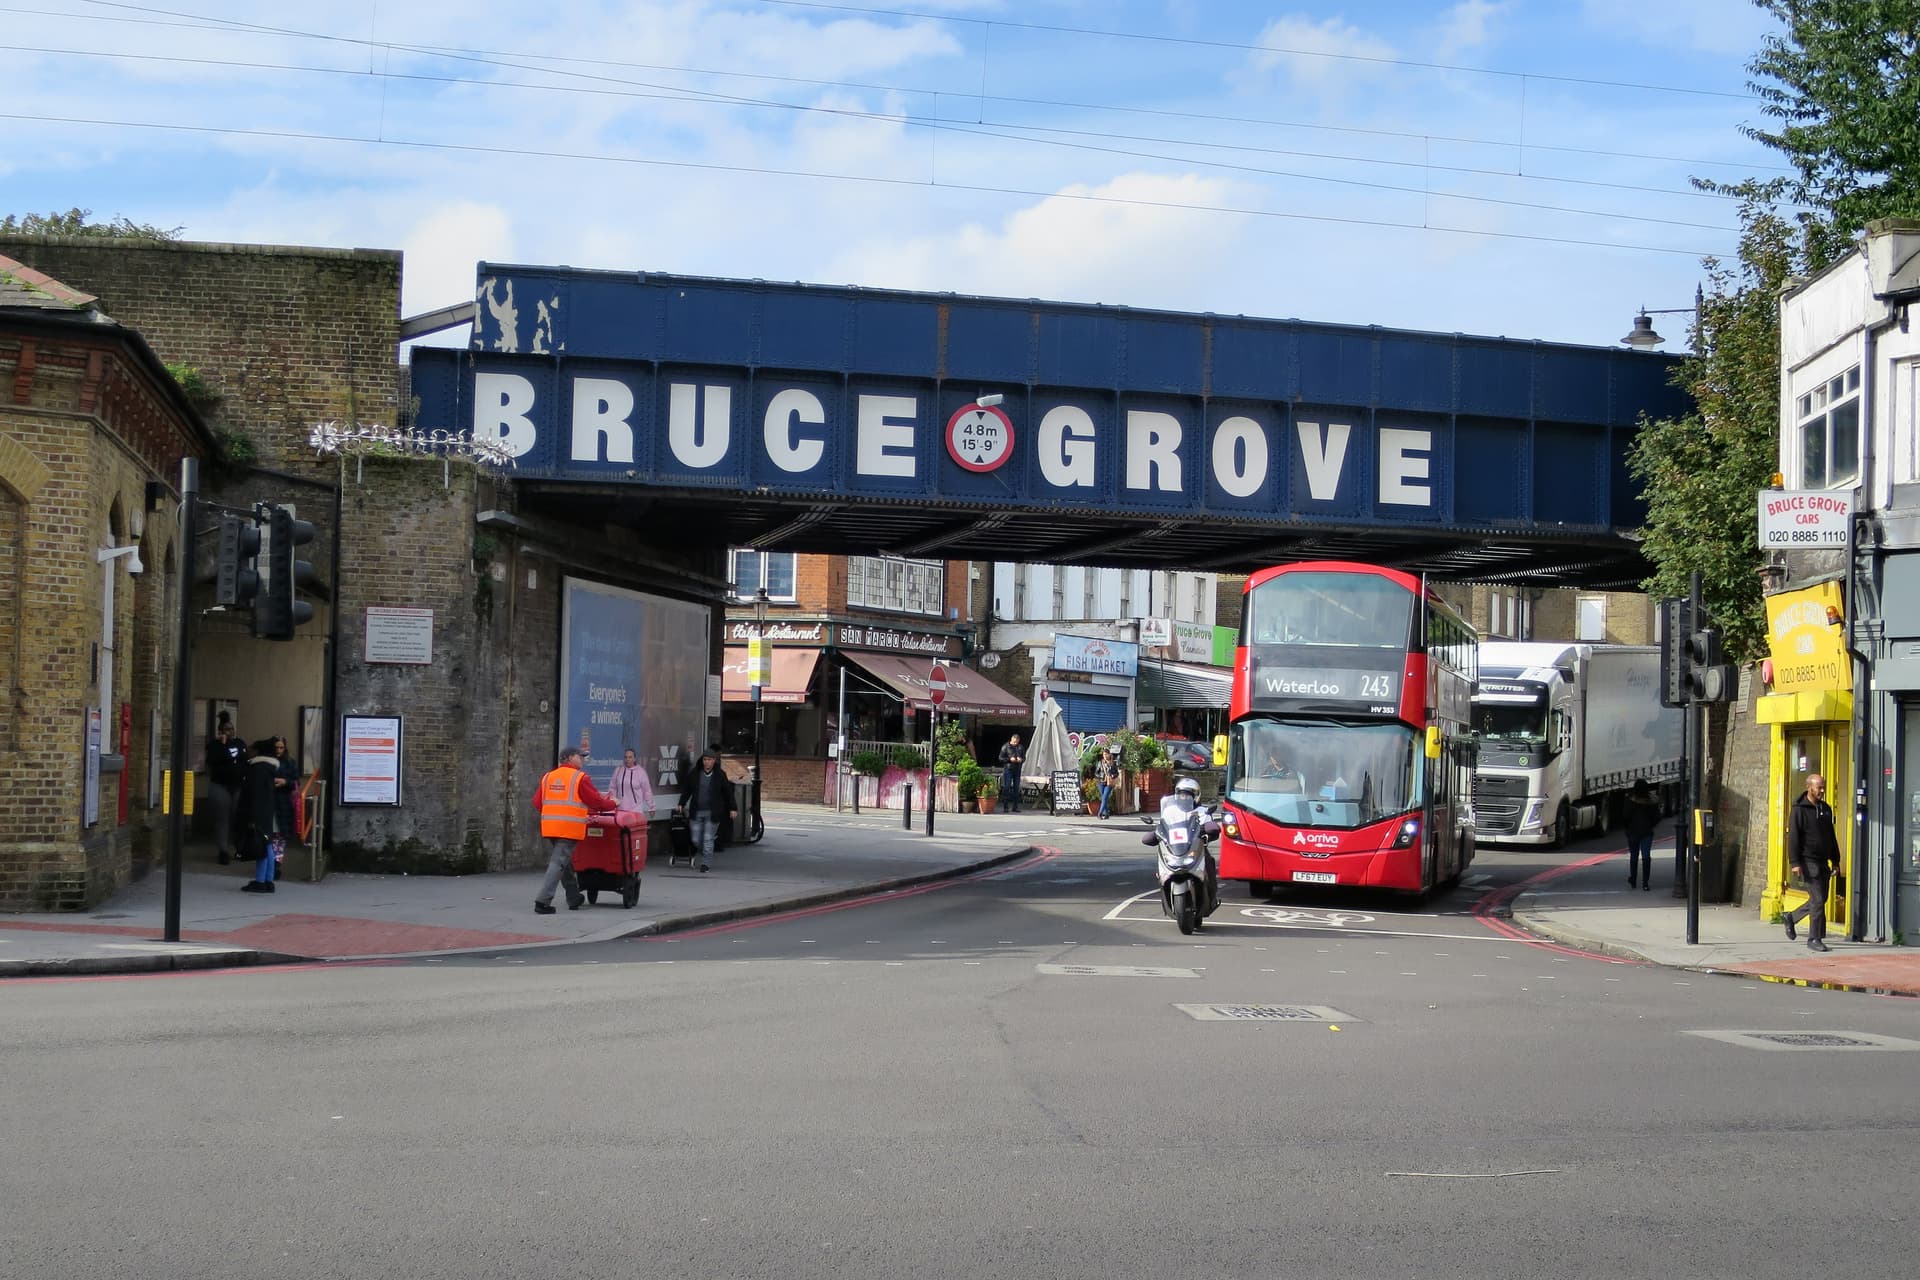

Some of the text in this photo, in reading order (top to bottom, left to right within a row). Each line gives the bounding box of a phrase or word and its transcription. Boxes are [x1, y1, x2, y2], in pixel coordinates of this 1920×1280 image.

[963, 424, 997, 437] 4.8m
[473, 372, 1432, 506] BRUCE GROVE
[1767, 496, 1848, 516] BRUCE GROVE
[1795, 513, 1820, 525] CARS
[1768, 530, 1847, 543] 020 8885 1110
[840, 628, 862, 644] SAN
[865, 631, 900, 648] MARCO
[1193, 626, 1212, 640] Grove
[1066, 655, 1126, 673] FISH MARKET
[1780, 662, 1837, 685] 020 8885 1110
[589, 682, 626, 704] Everyone's
[1266, 675, 1390, 697] Waterloo 243
[591, 709, 623, 725] a winner.
[658, 758, 679, 772] HALIFAX
[1174, 831, 1184, 841] L
[1307, 832, 1339, 844] arriva
[1295, 872, 1333, 882] LF67 EUY
